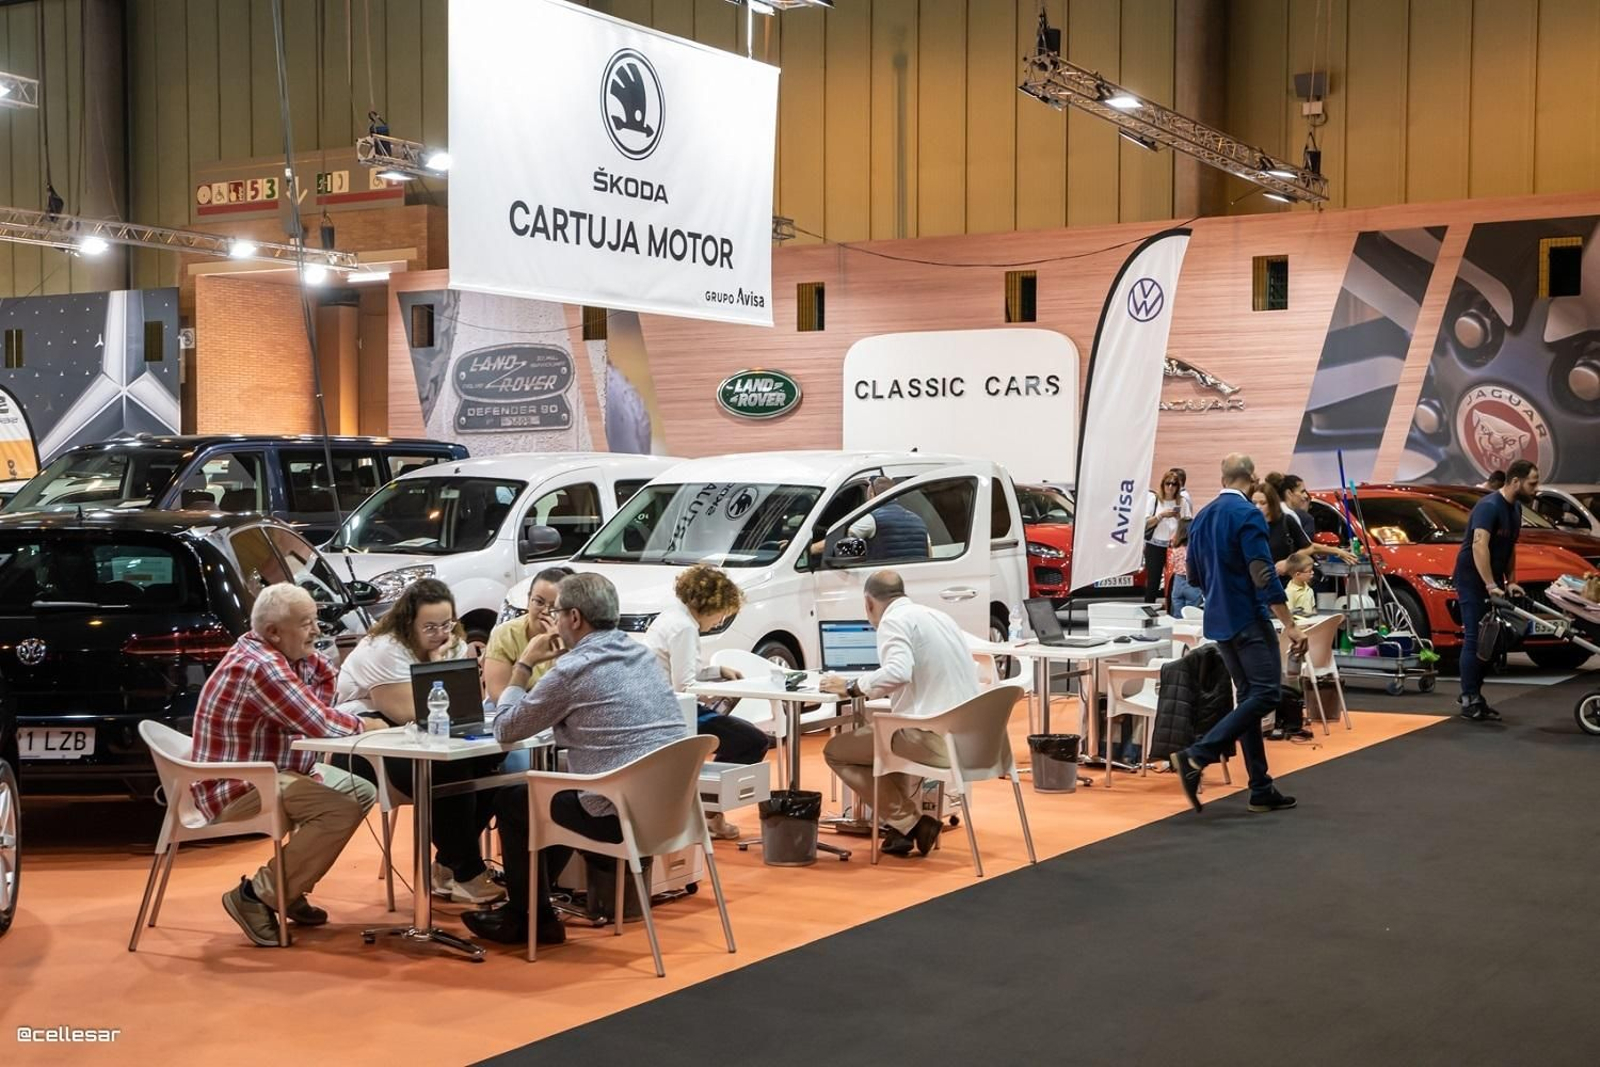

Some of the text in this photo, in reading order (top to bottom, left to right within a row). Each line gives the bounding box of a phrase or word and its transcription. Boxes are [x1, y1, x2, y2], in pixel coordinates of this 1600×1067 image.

[593, 167, 669, 204] ŠKODA
[509, 200, 734, 269] CARTUJA MOTOR
[705, 287, 765, 307] GRUPO Avisa
[469, 354, 518, 372] LAND
[498, 374, 558, 392] ROVER
[734, 378, 775, 393] LAND
[854, 374, 1060, 400] CLASSIC CARS
[737, 391, 787, 407] ROVER
[1159, 399, 1245, 411] AGUAR
[467, 404, 558, 417] DEFENDER 90
[1466, 388, 1547, 439] JAGUAR
[1111, 479, 1135, 545] Avisa
[45, 730, 87, 751] LZB
